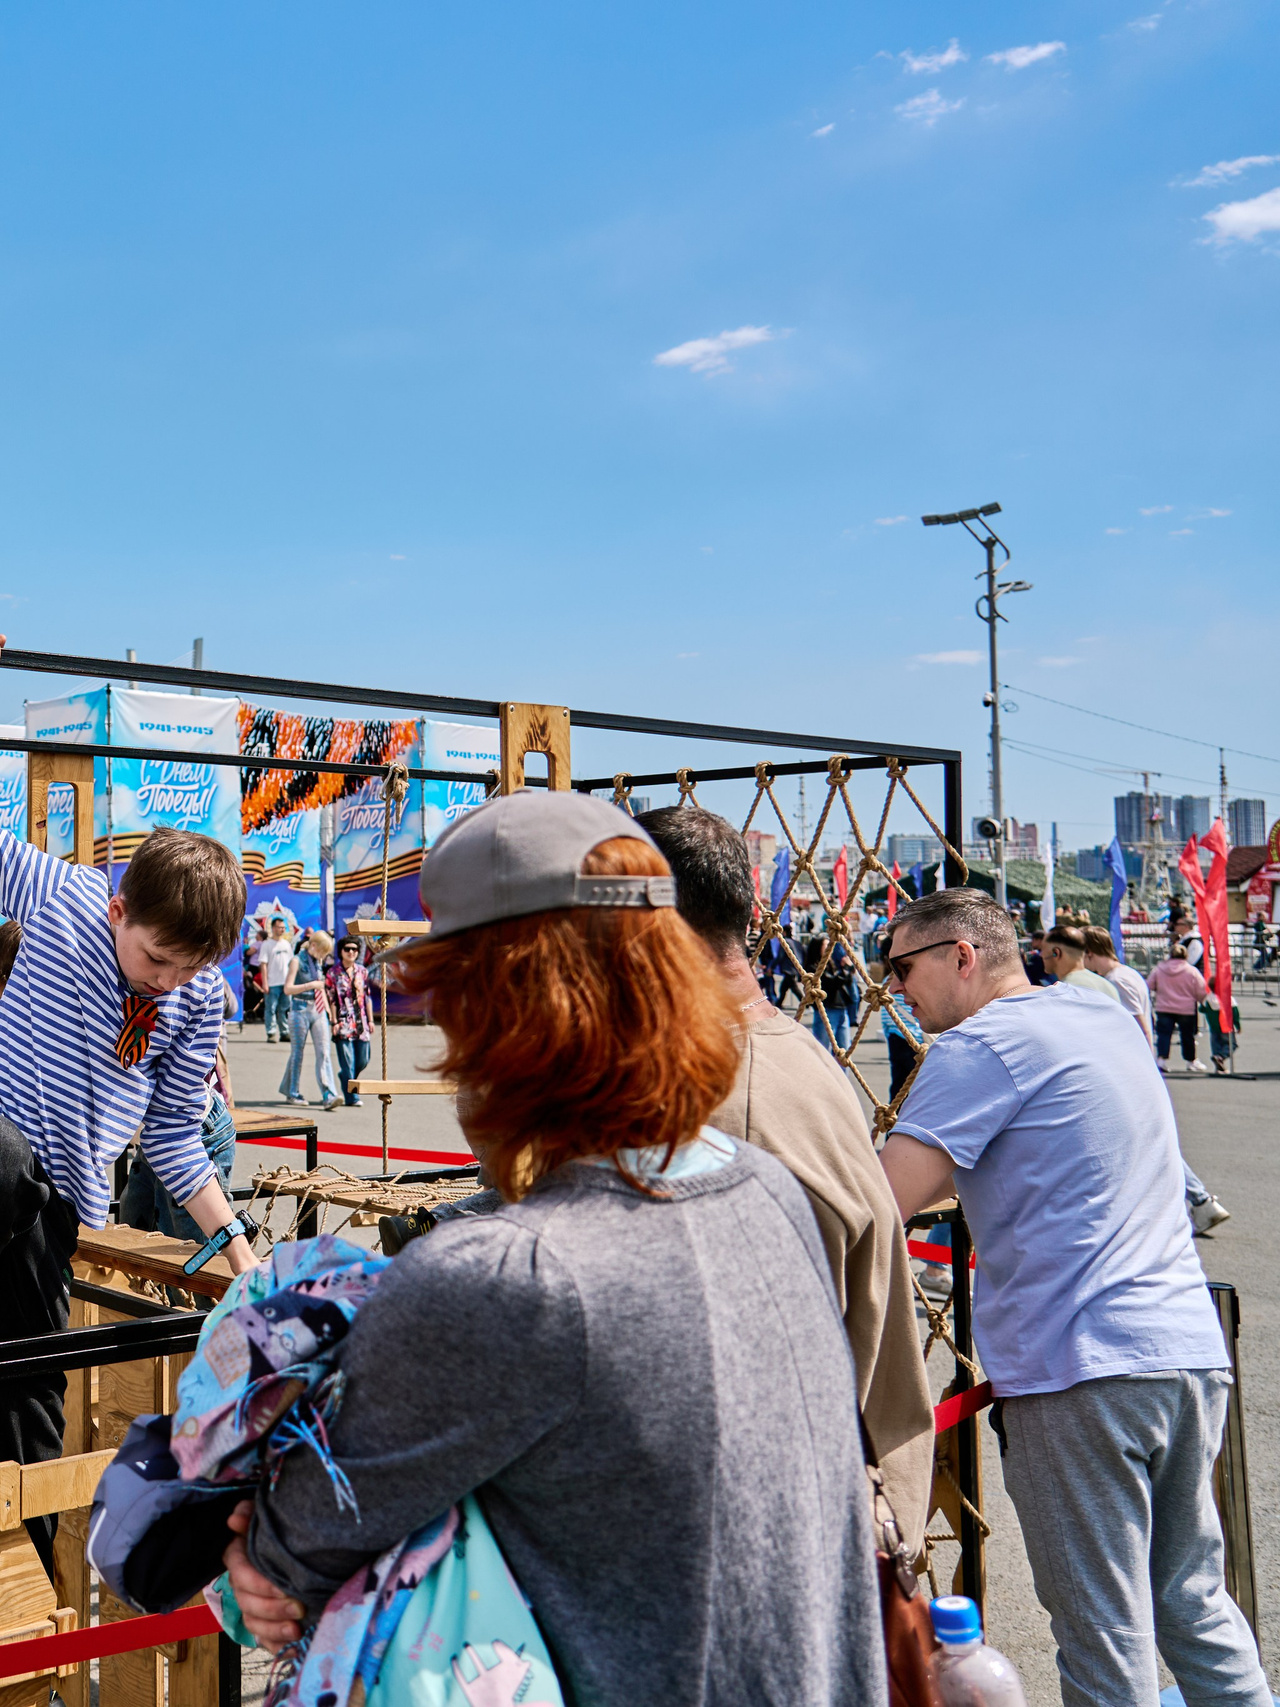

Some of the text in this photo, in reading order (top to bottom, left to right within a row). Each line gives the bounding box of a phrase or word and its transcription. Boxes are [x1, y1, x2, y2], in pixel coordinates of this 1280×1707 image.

[36, 721, 93, 738] 1941-1945
[139, 722, 214, 735] 1941-1945
[136, 784, 218, 830] Победы!
